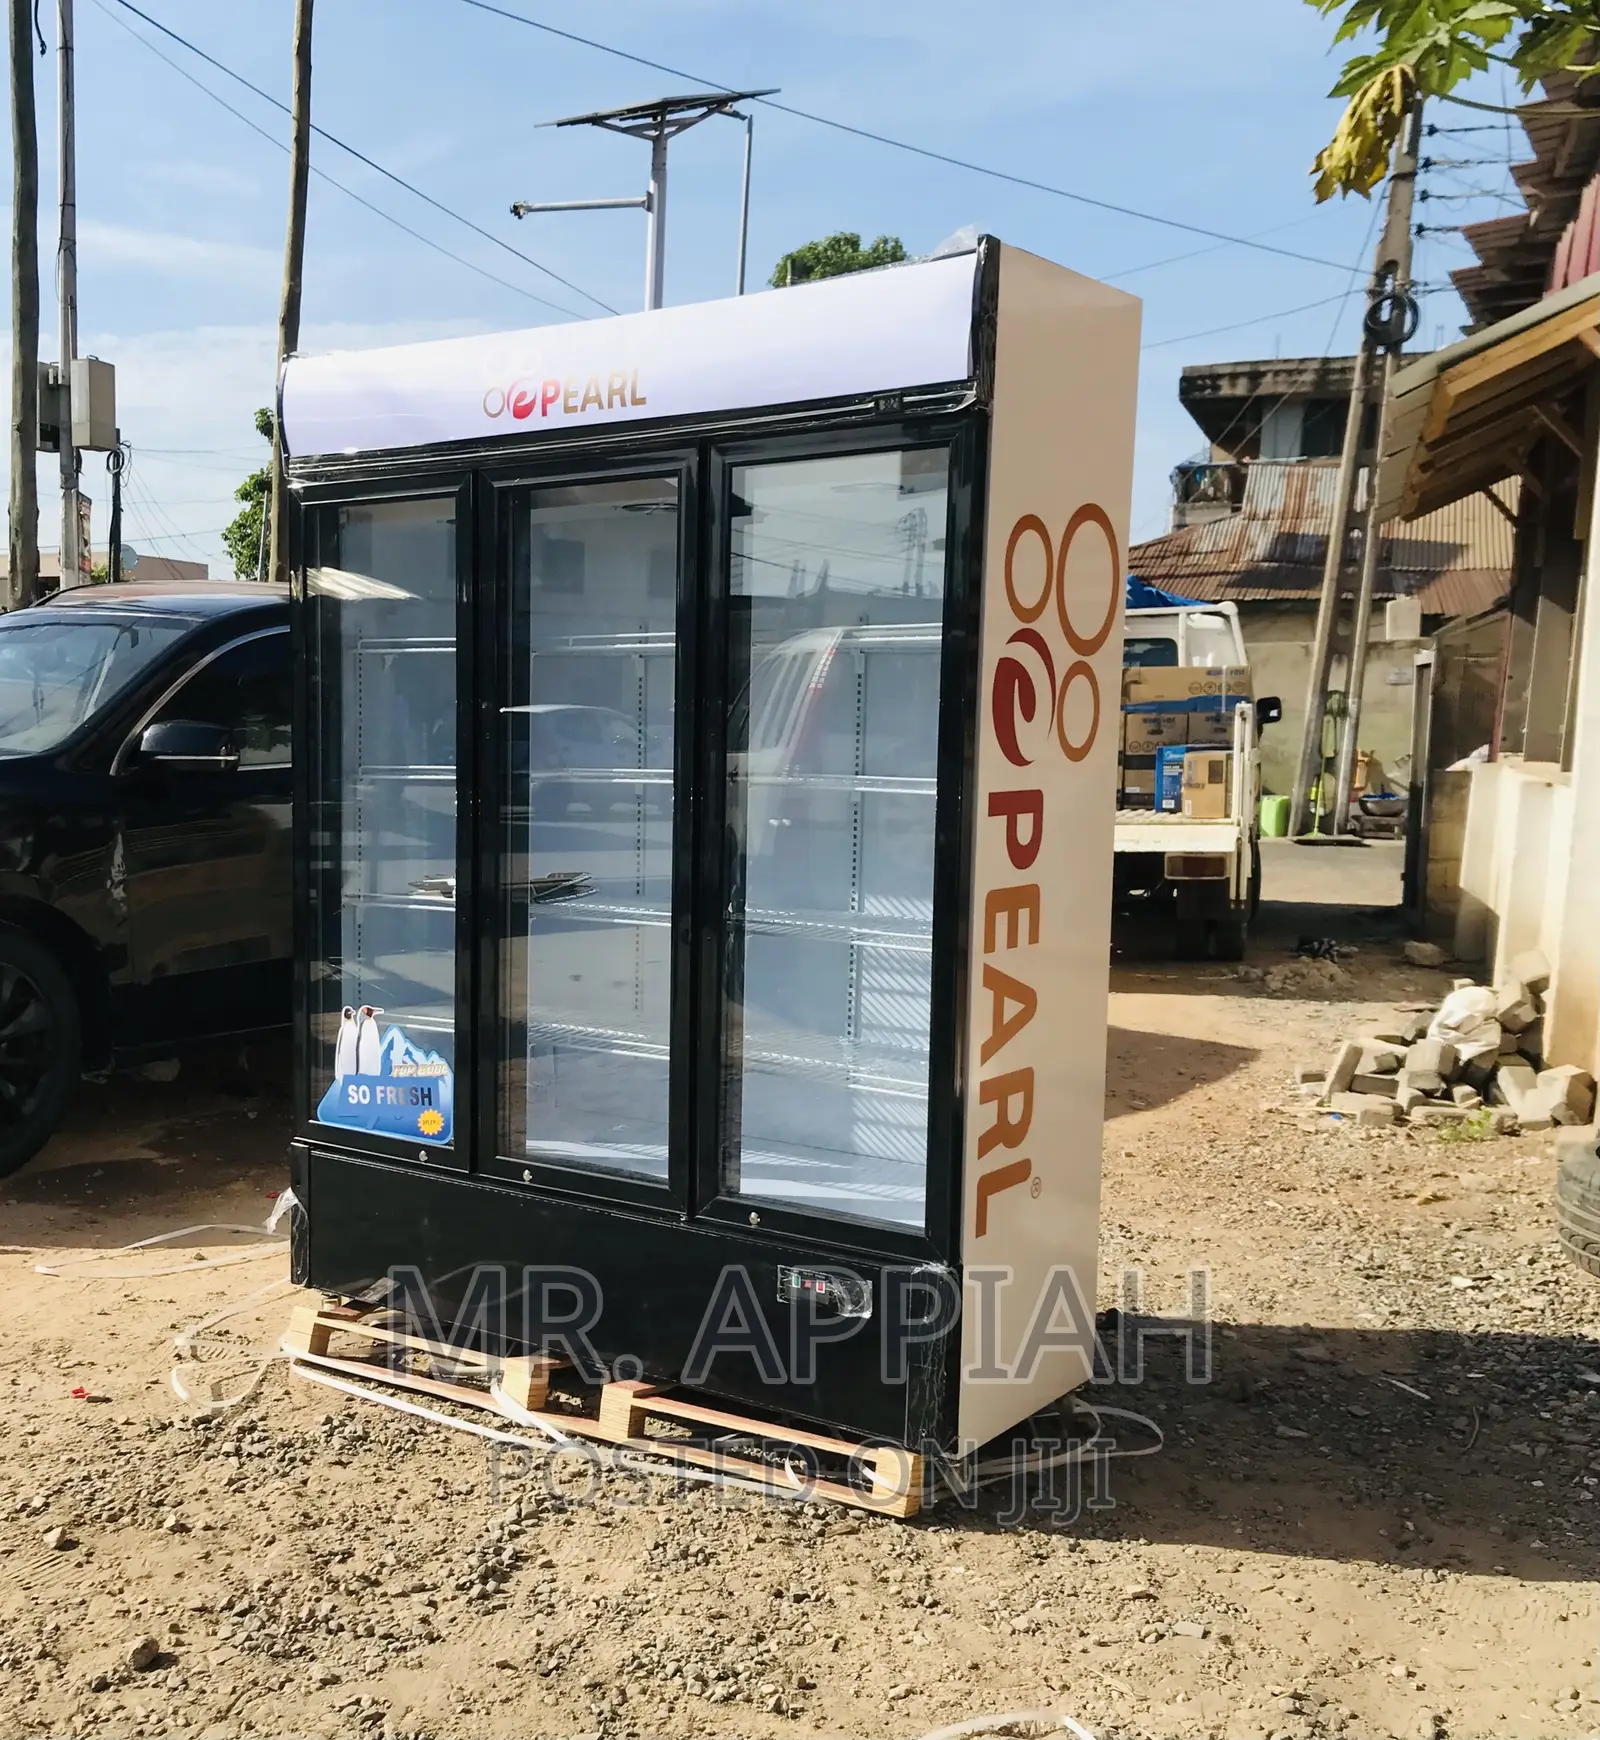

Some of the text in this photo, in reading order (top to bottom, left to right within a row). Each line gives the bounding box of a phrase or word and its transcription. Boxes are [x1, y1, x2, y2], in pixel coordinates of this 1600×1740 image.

[541, 367, 647, 417] PEARL
[975, 789, 1044, 1238] PEARL
[347, 1084, 432, 1106] SO FRESH
